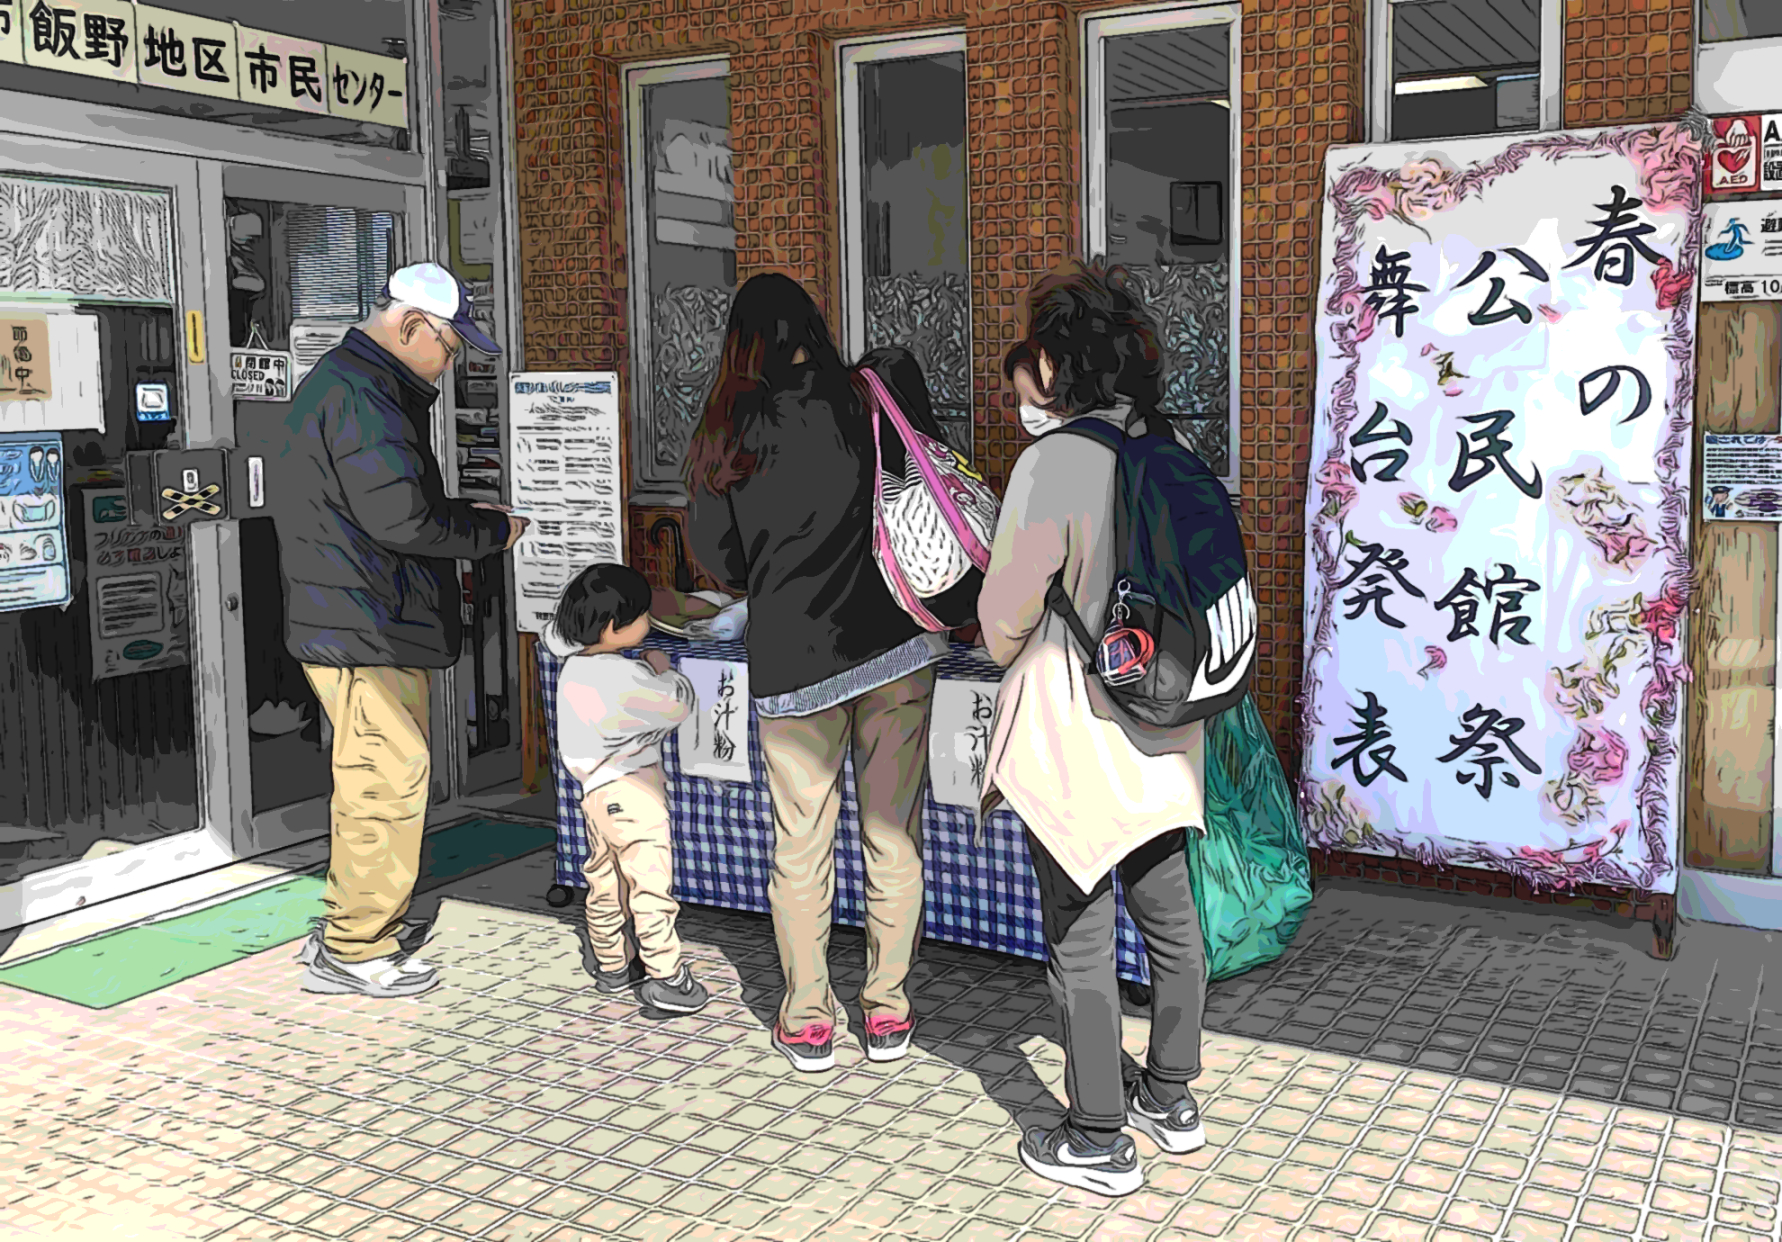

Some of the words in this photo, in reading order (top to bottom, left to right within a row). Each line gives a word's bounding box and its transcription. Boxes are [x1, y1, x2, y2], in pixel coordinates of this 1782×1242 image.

[1717, 175, 1748, 184] AED
[231, 370, 265, 381] CLOSED
[1561, 185, 1663, 425] 春の
[1331, 244, 1430, 788] 舞台発表
[1434, 247, 1549, 801] 公民館祭
[714, 669, 737, 762] お汁粉
